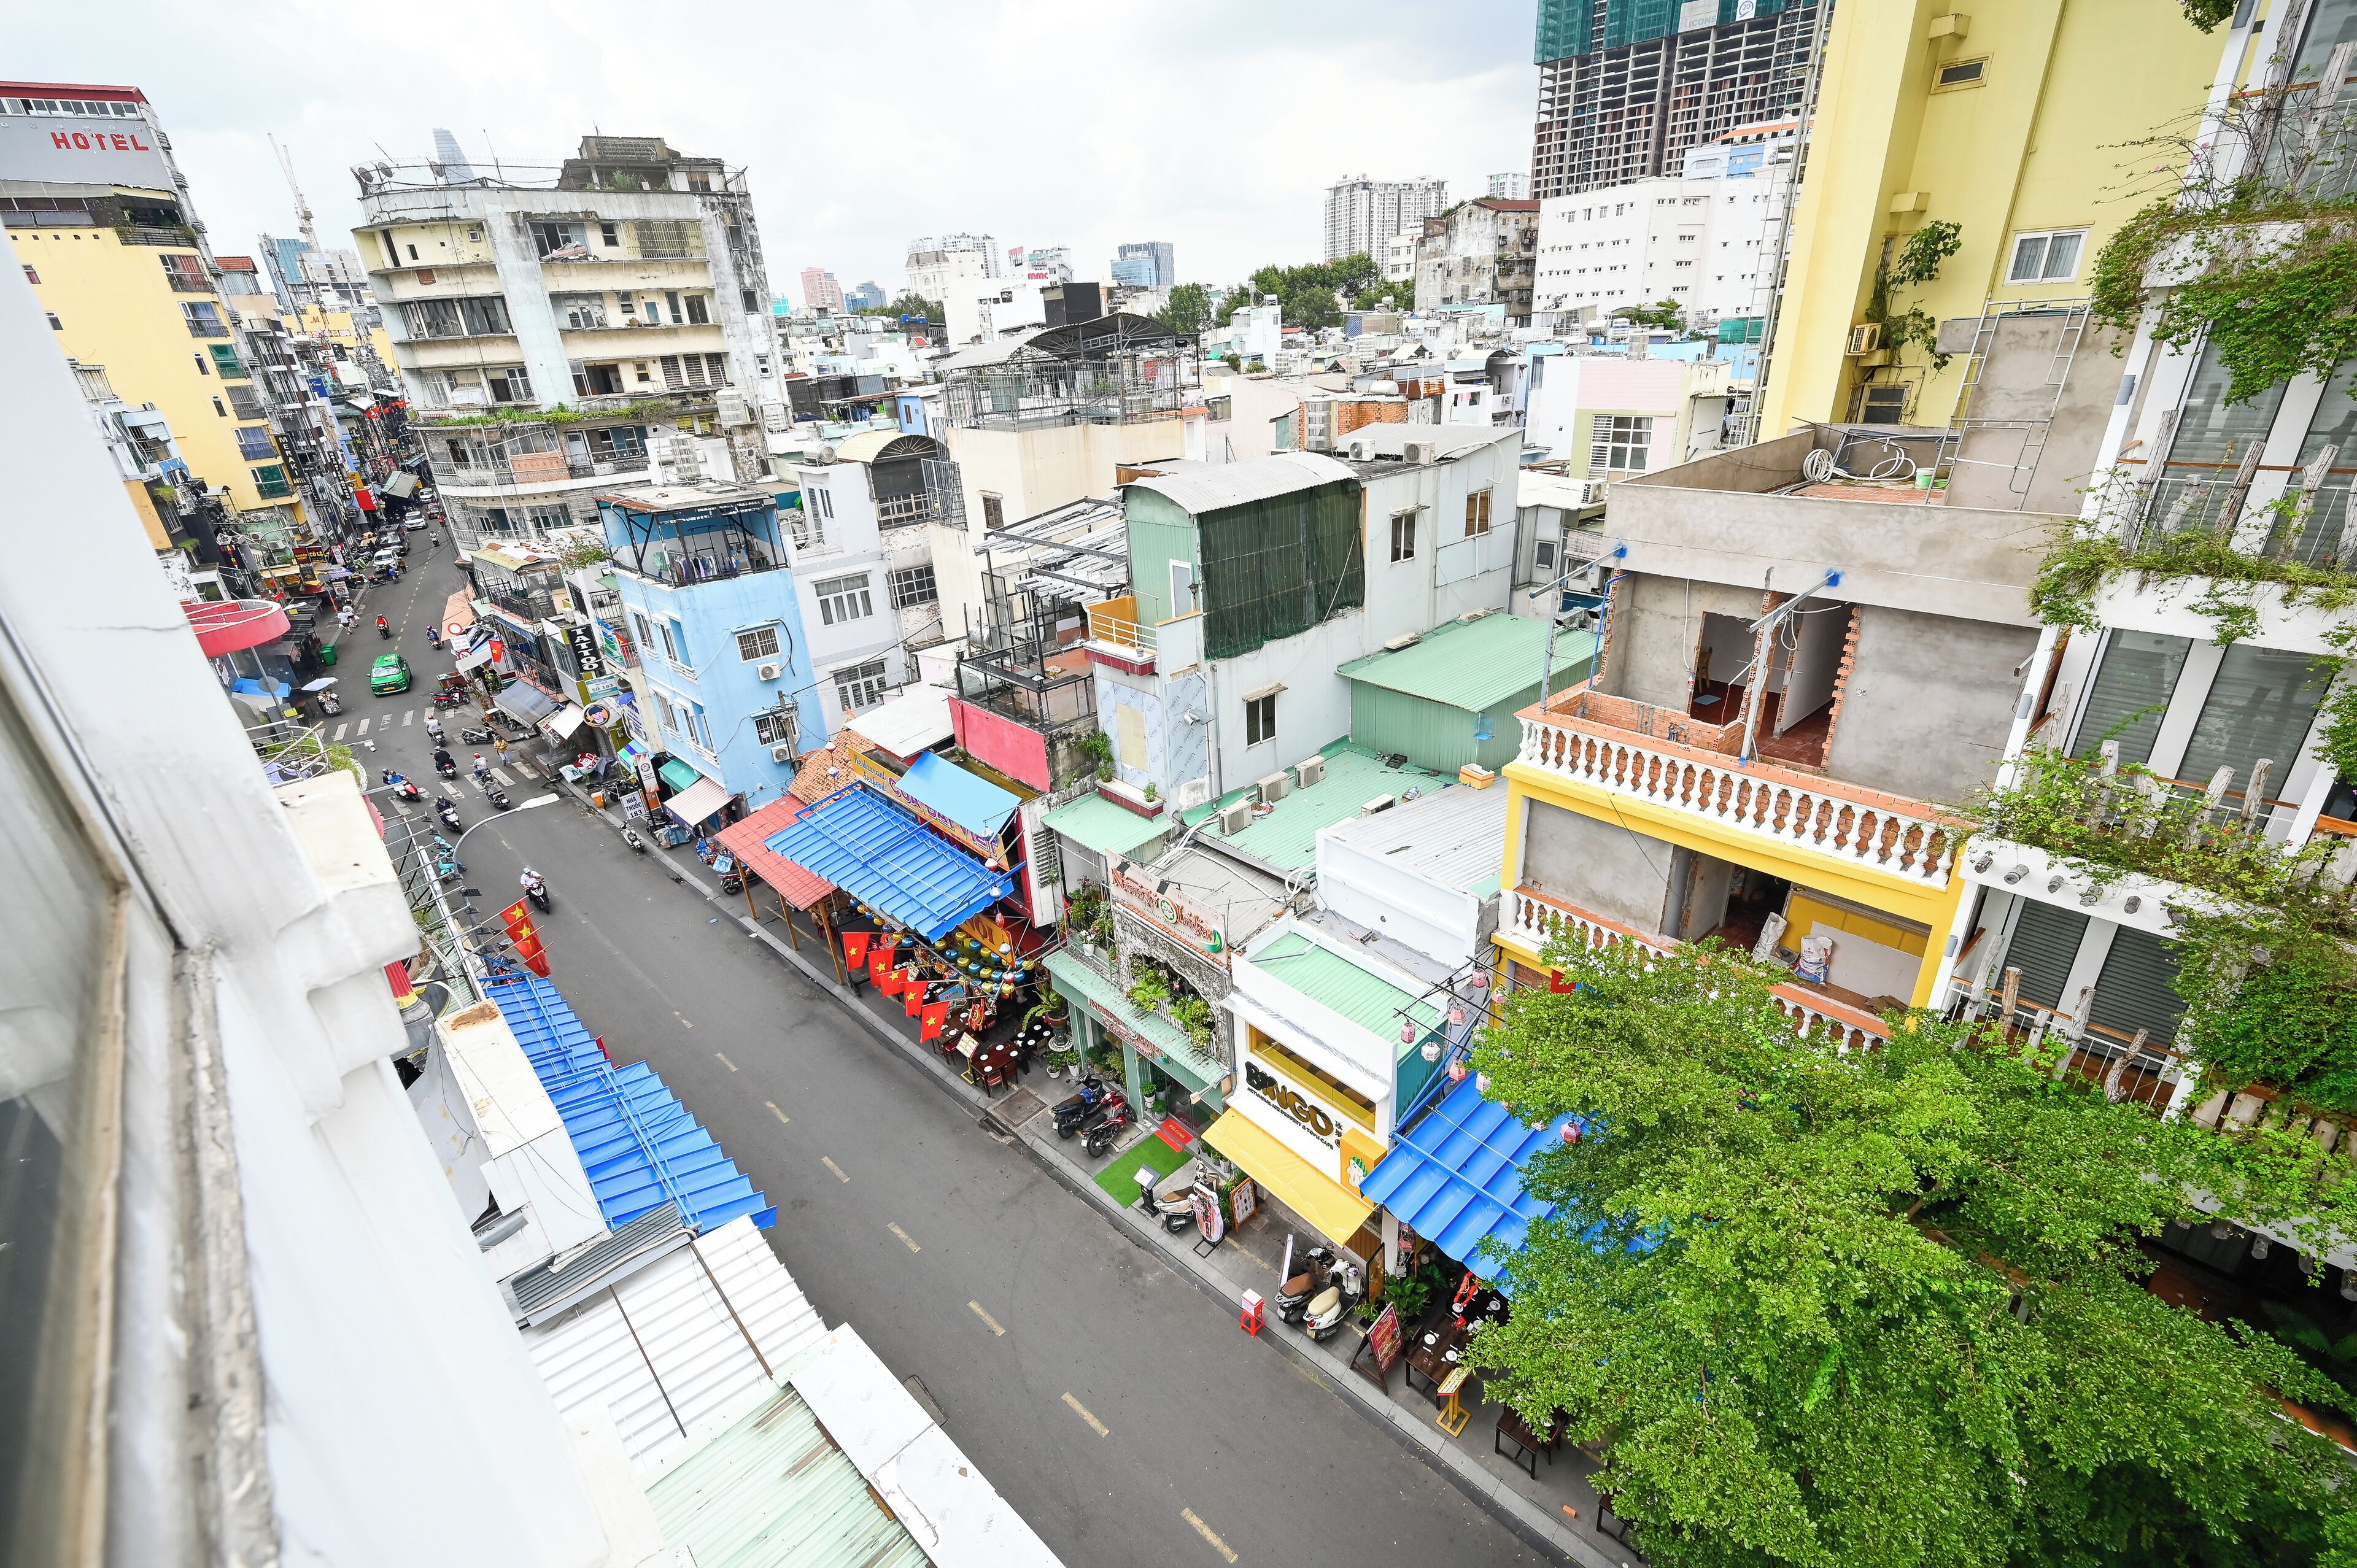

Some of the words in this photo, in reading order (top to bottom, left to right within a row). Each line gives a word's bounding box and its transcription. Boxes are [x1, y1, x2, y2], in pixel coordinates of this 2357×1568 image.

[50, 131, 150, 151] HOTEL
[278, 436, 300, 477] MERAKI
[570, 627, 599, 671] TATTOO
[854, 754, 886, 782] Restaurant
[862, 771, 886, 792] Seafood
[625, 801, 642, 813] THUỐC
[626, 795, 637, 805] NHÀ
[1245, 1061, 1334, 1136] BINGO
[1168, 1124, 1186, 1139] WELCOME
[1272, 1103, 1280, 1113] ICE
[1306, 1127, 1320, 1140] TOFU
[982, 1512, 996, 1533] VINA
